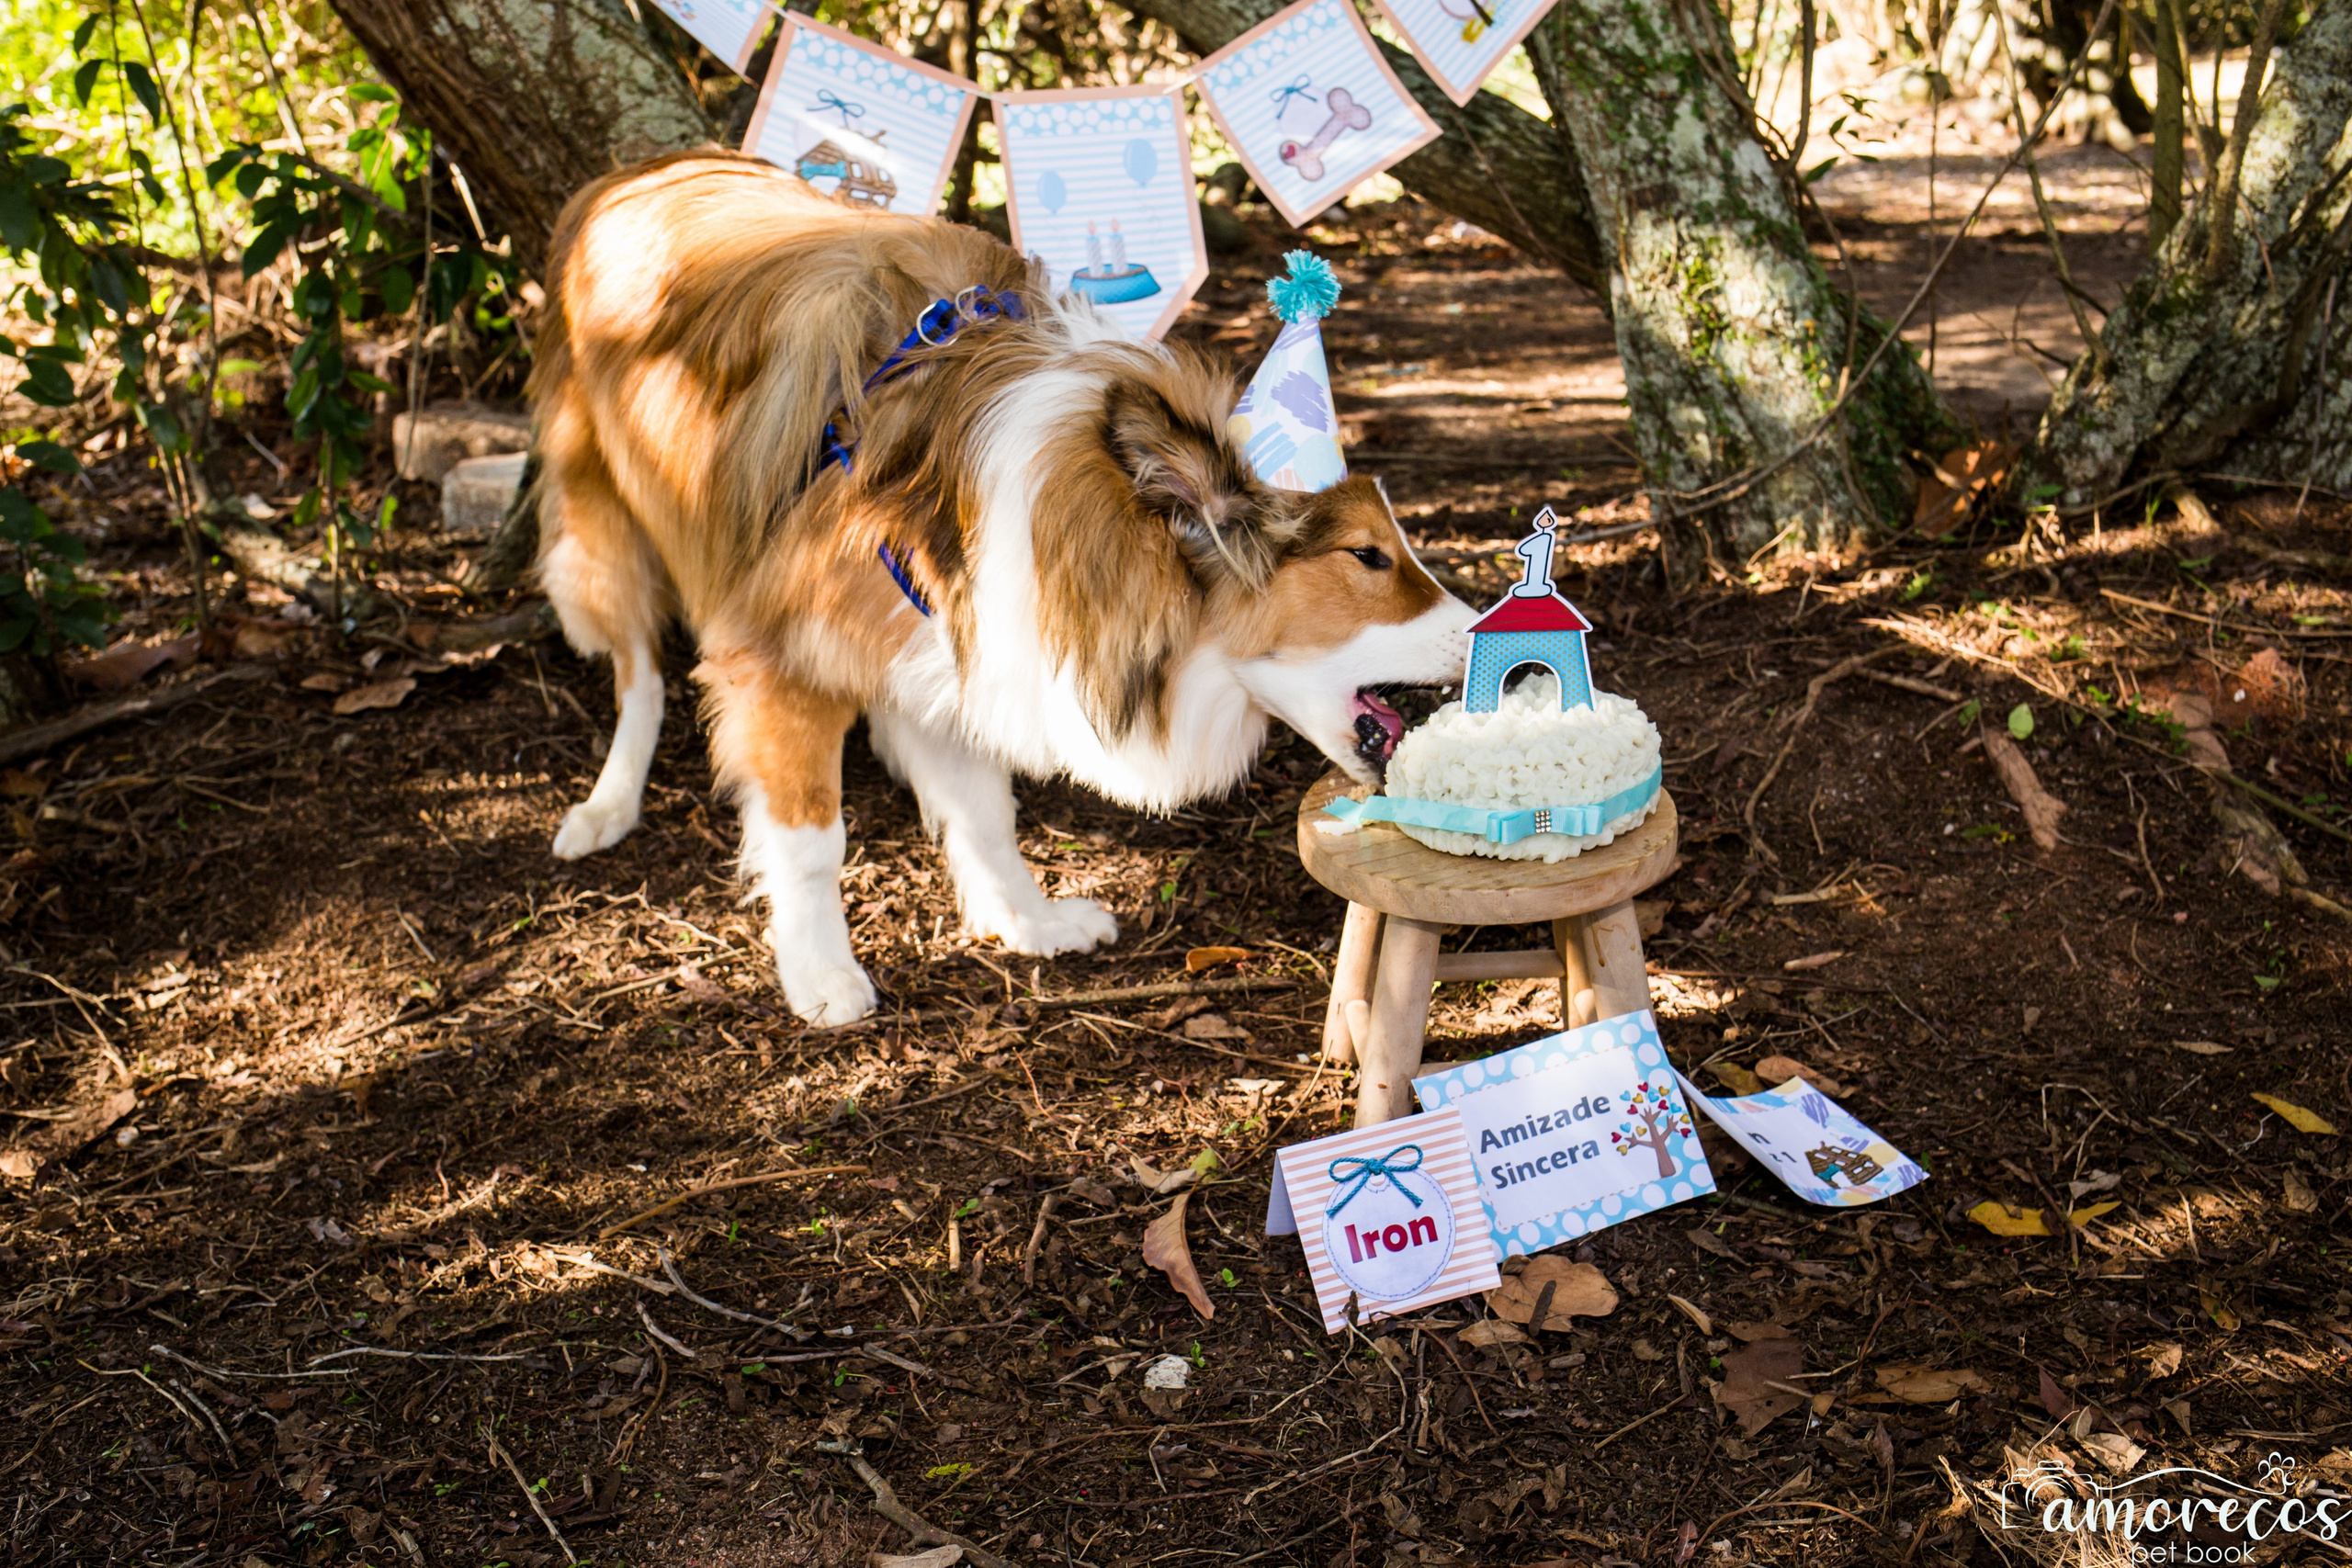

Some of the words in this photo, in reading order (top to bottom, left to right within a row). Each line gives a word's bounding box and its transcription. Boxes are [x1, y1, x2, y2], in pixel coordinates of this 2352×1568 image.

[1481, 1096, 1611, 1154] Amizade
[1491, 1140, 1600, 1190] Sincera
[1344, 1216, 1439, 1264] Iron
